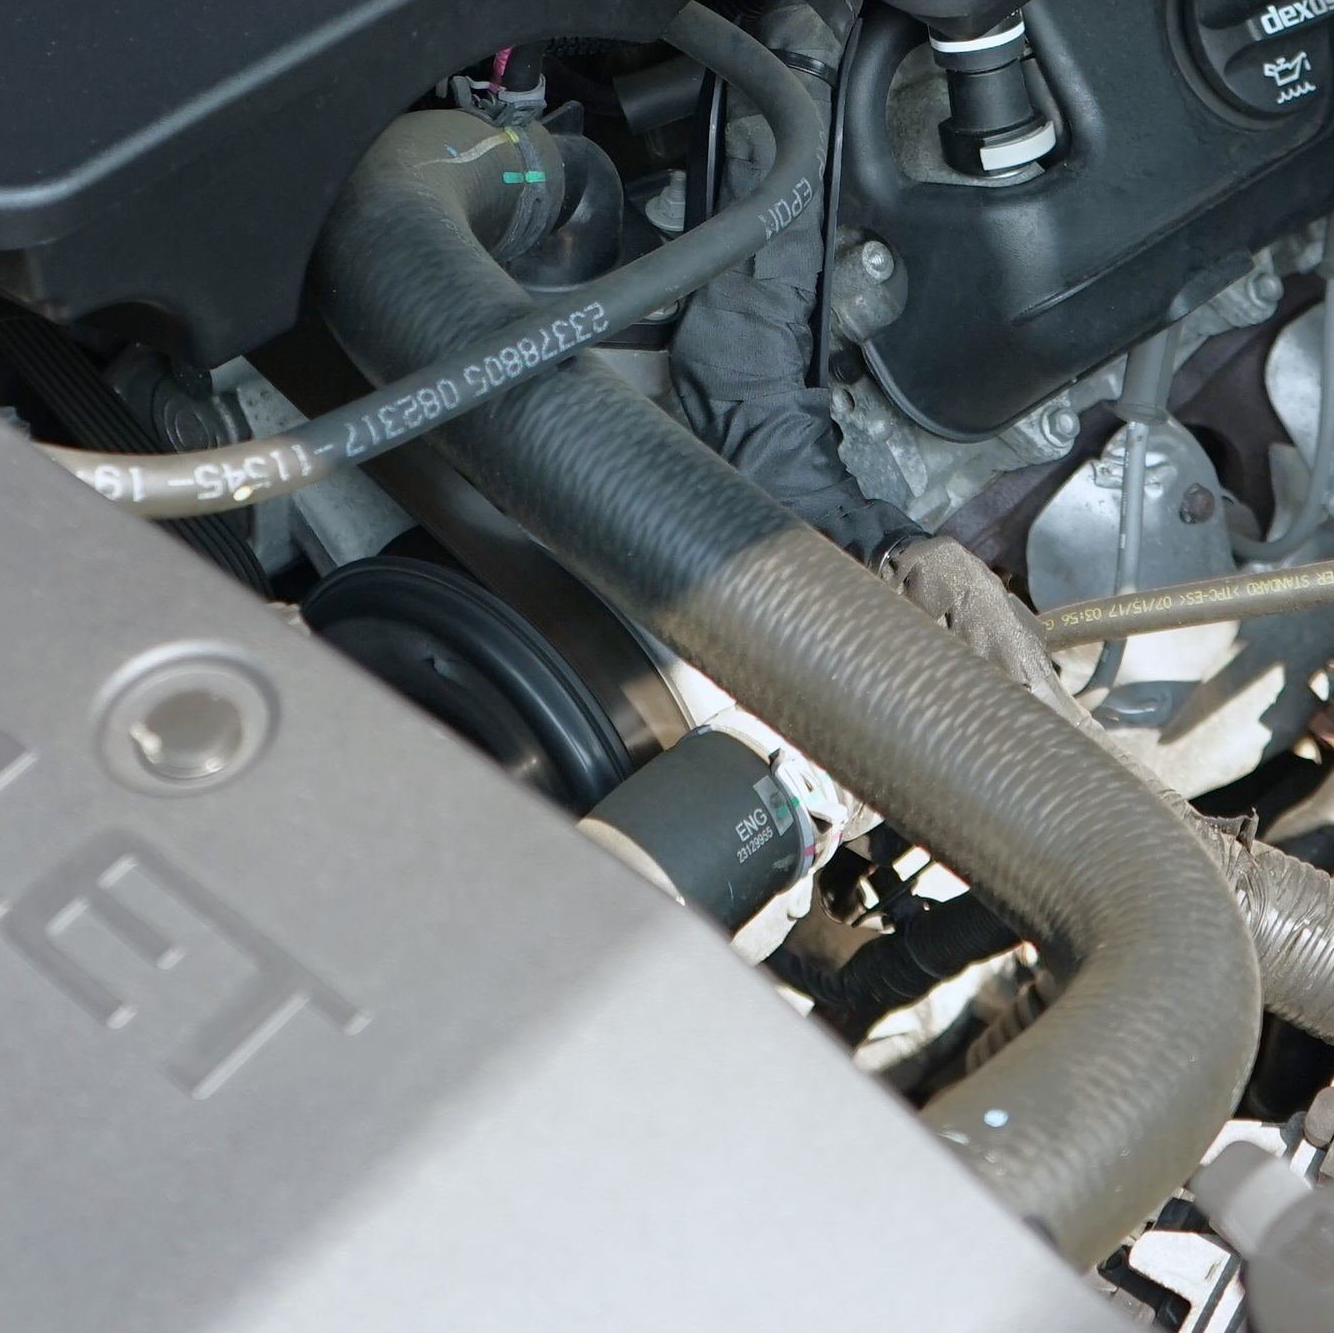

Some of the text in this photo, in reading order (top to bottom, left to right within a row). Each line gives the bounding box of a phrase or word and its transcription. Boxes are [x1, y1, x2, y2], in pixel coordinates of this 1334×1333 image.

[1246, 574, 1311, 596] STANDARD
[1060, 607, 1101, 627] 03:56
[736, 808, 768, 842] ENG
[737, 826, 773, 864] 23129955
